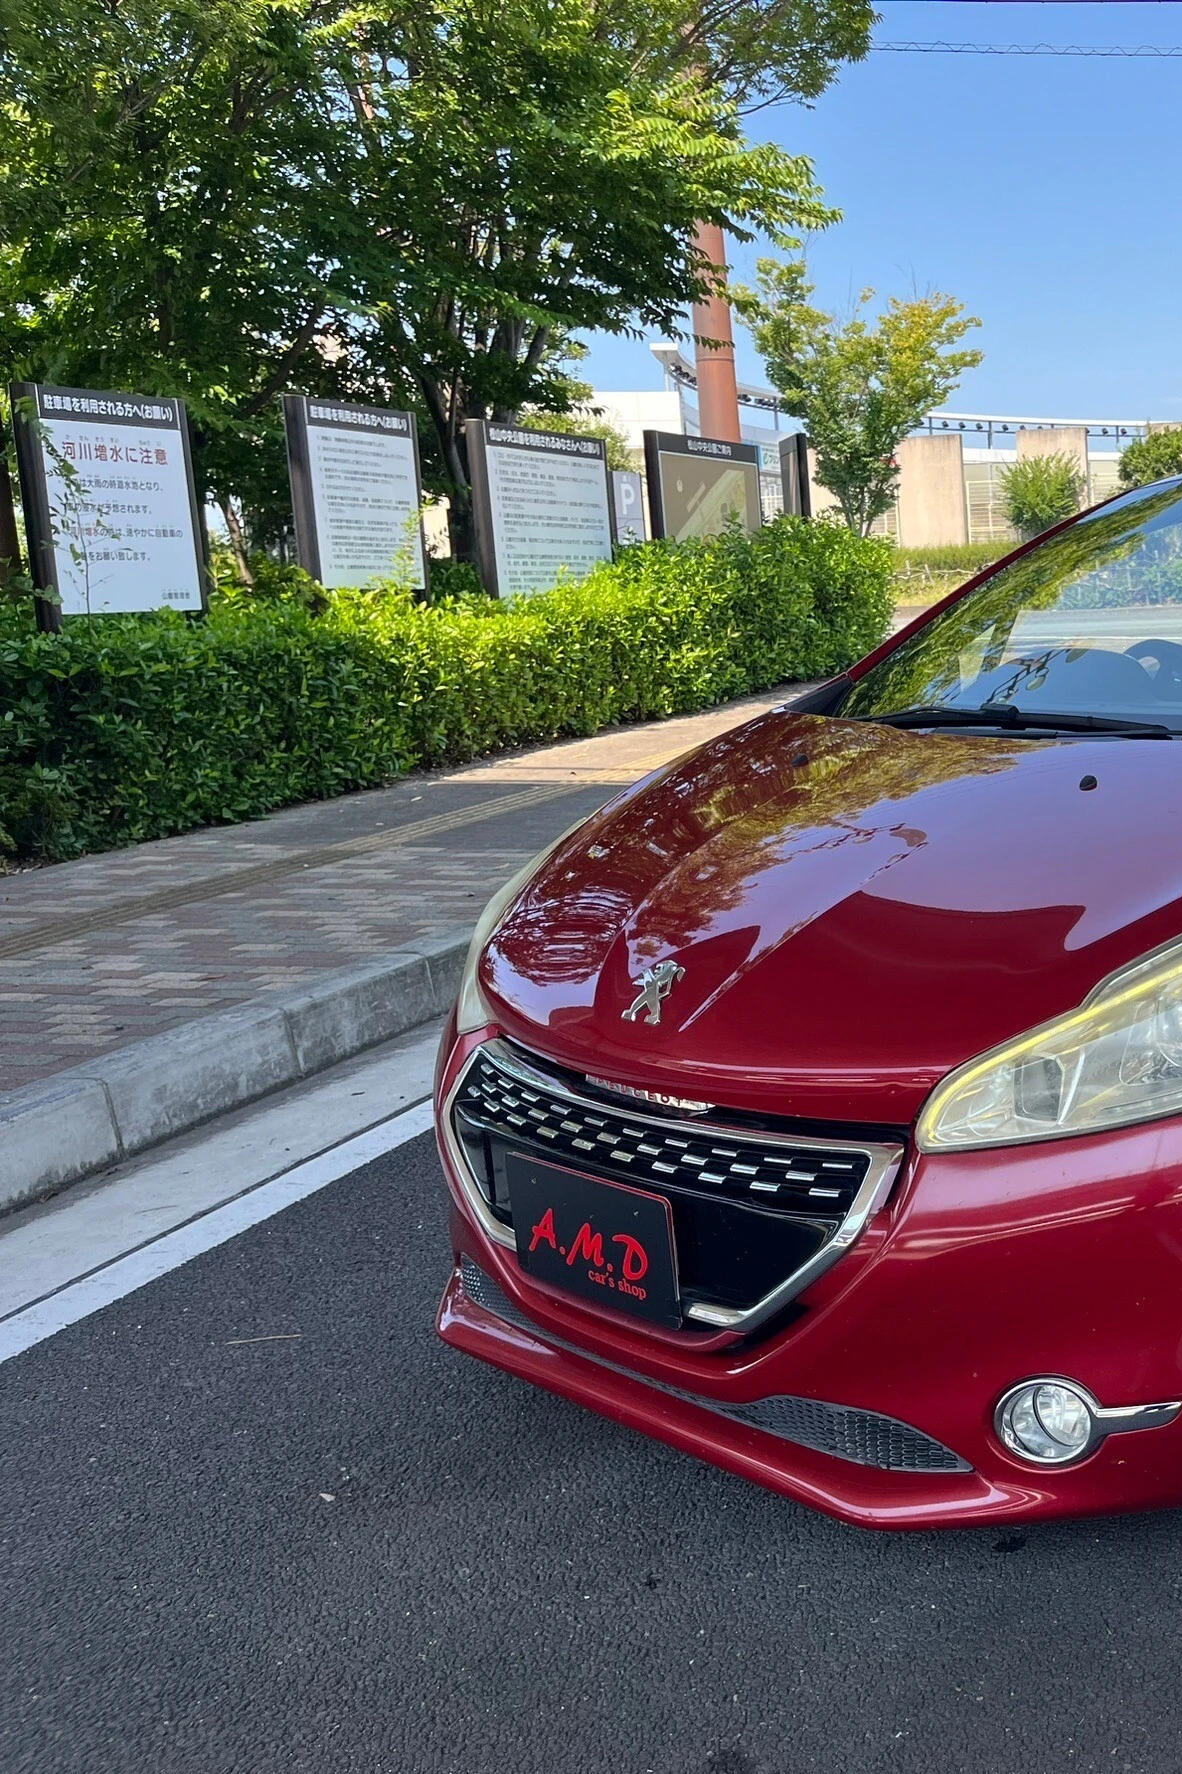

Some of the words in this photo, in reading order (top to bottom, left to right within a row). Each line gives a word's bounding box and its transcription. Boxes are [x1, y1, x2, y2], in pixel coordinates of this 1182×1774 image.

[43, 394, 173, 422] 駐車場を利用される方へ(お願い)
[61, 441, 168, 466] 河川増水に注意
[620, 483, 635, 515] P
[528, 1207, 649, 1281] A.M.D
[588, 1269, 615, 1289] car's
[618, 1278, 647, 1300] shop
